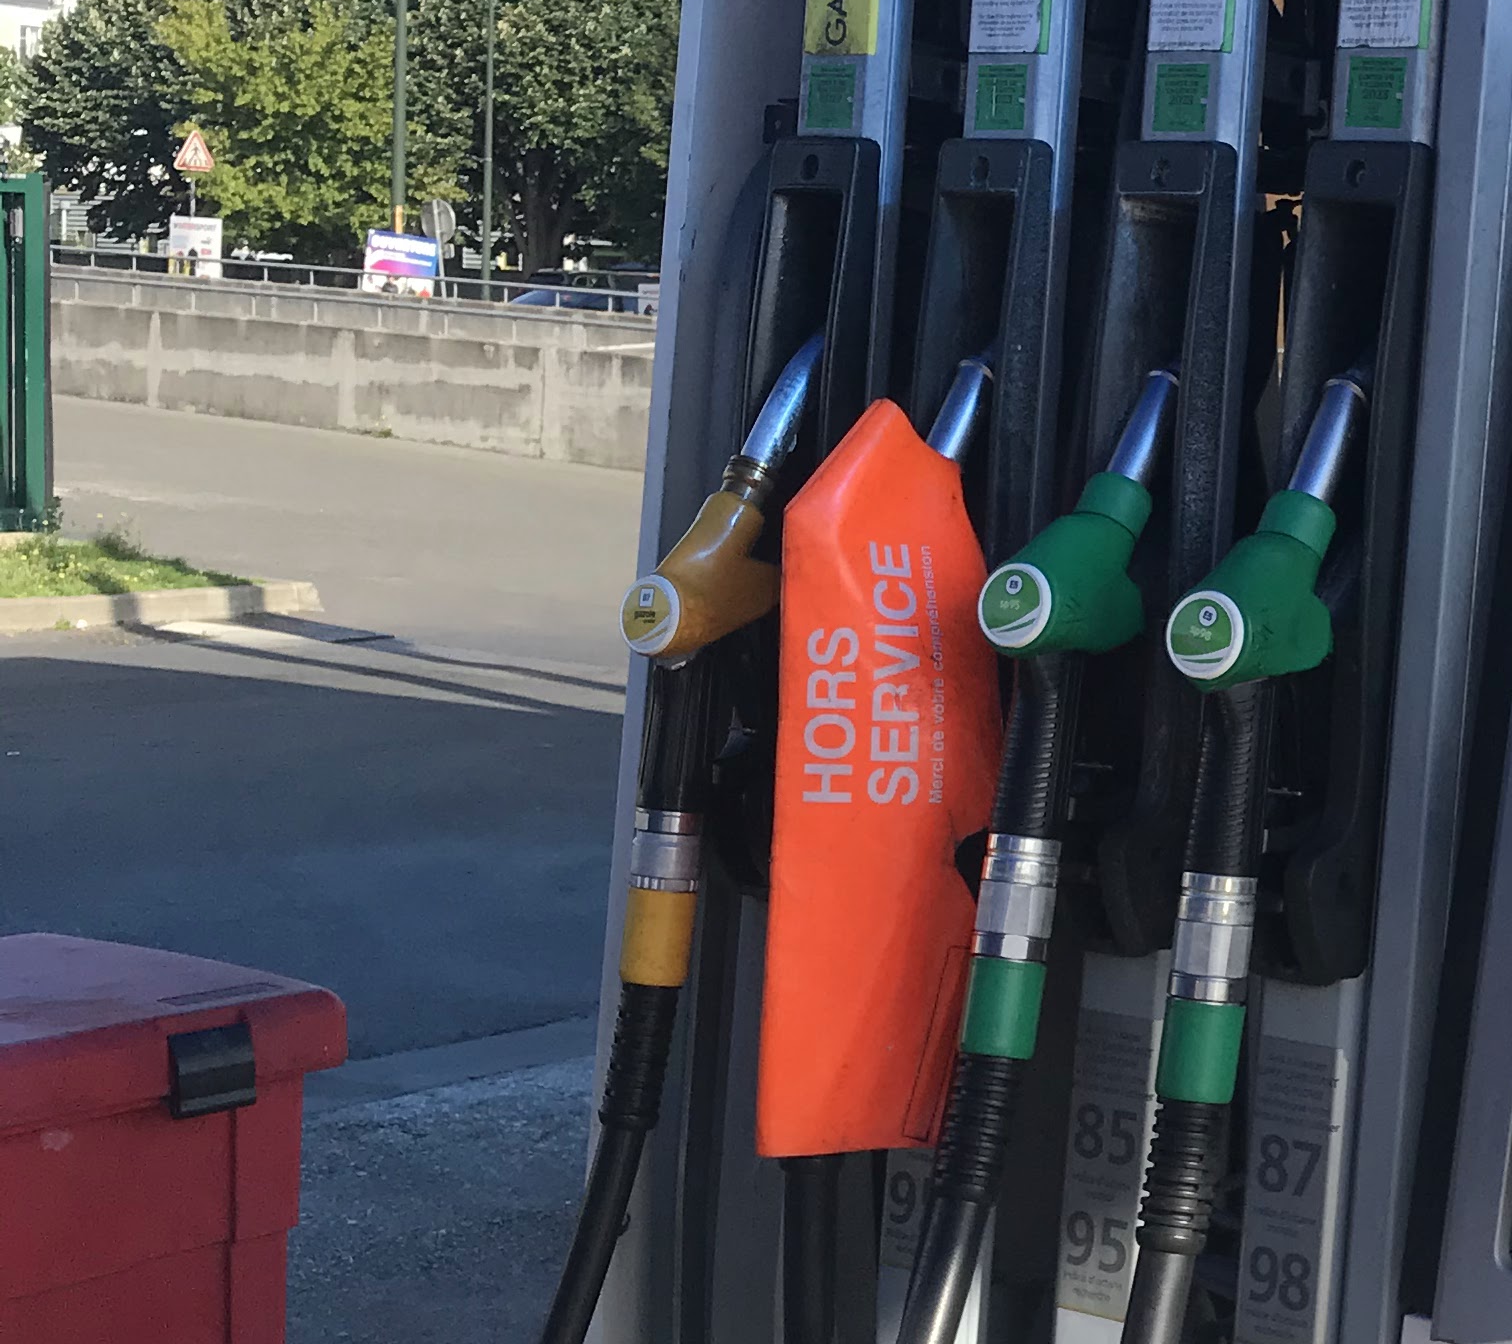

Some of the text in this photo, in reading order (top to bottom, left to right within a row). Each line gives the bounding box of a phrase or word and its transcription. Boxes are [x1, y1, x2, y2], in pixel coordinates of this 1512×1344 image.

[867, 541, 921, 806] SERVICE
[931, 677, 945, 724] votre
[802, 627, 859, 804] HORS
[930, 730, 944, 751] de
[929, 757, 944, 805] Merci
[1074, 1103, 1138, 1166] 85
[1257, 1133, 1323, 1197] 87
[1066, 1210, 1129, 1274] 95
[1248, 1245, 1311, 1311] 98
